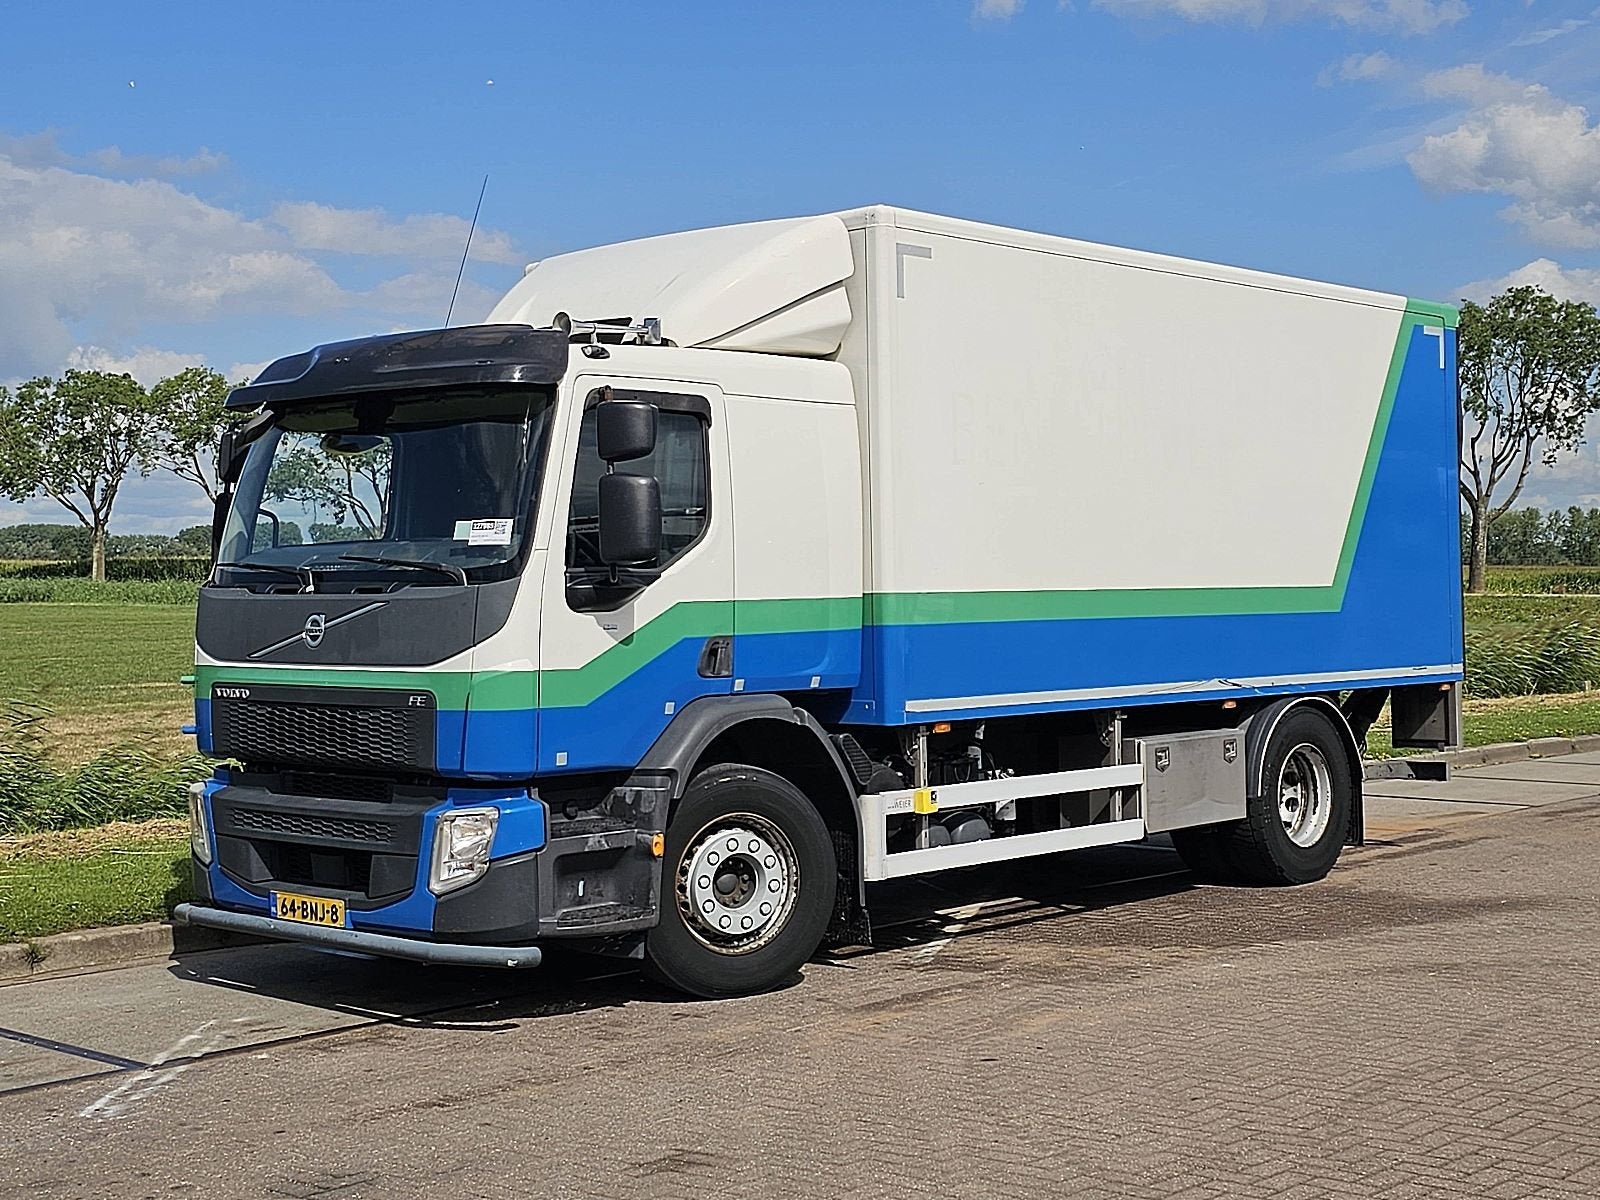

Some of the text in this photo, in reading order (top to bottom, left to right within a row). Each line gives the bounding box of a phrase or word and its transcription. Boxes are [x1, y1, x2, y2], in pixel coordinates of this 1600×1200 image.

[214, 687, 250, 699] VOLVO
[408, 695, 427, 706] FE
[280, 897, 339, 924] 64-BNJ-8
